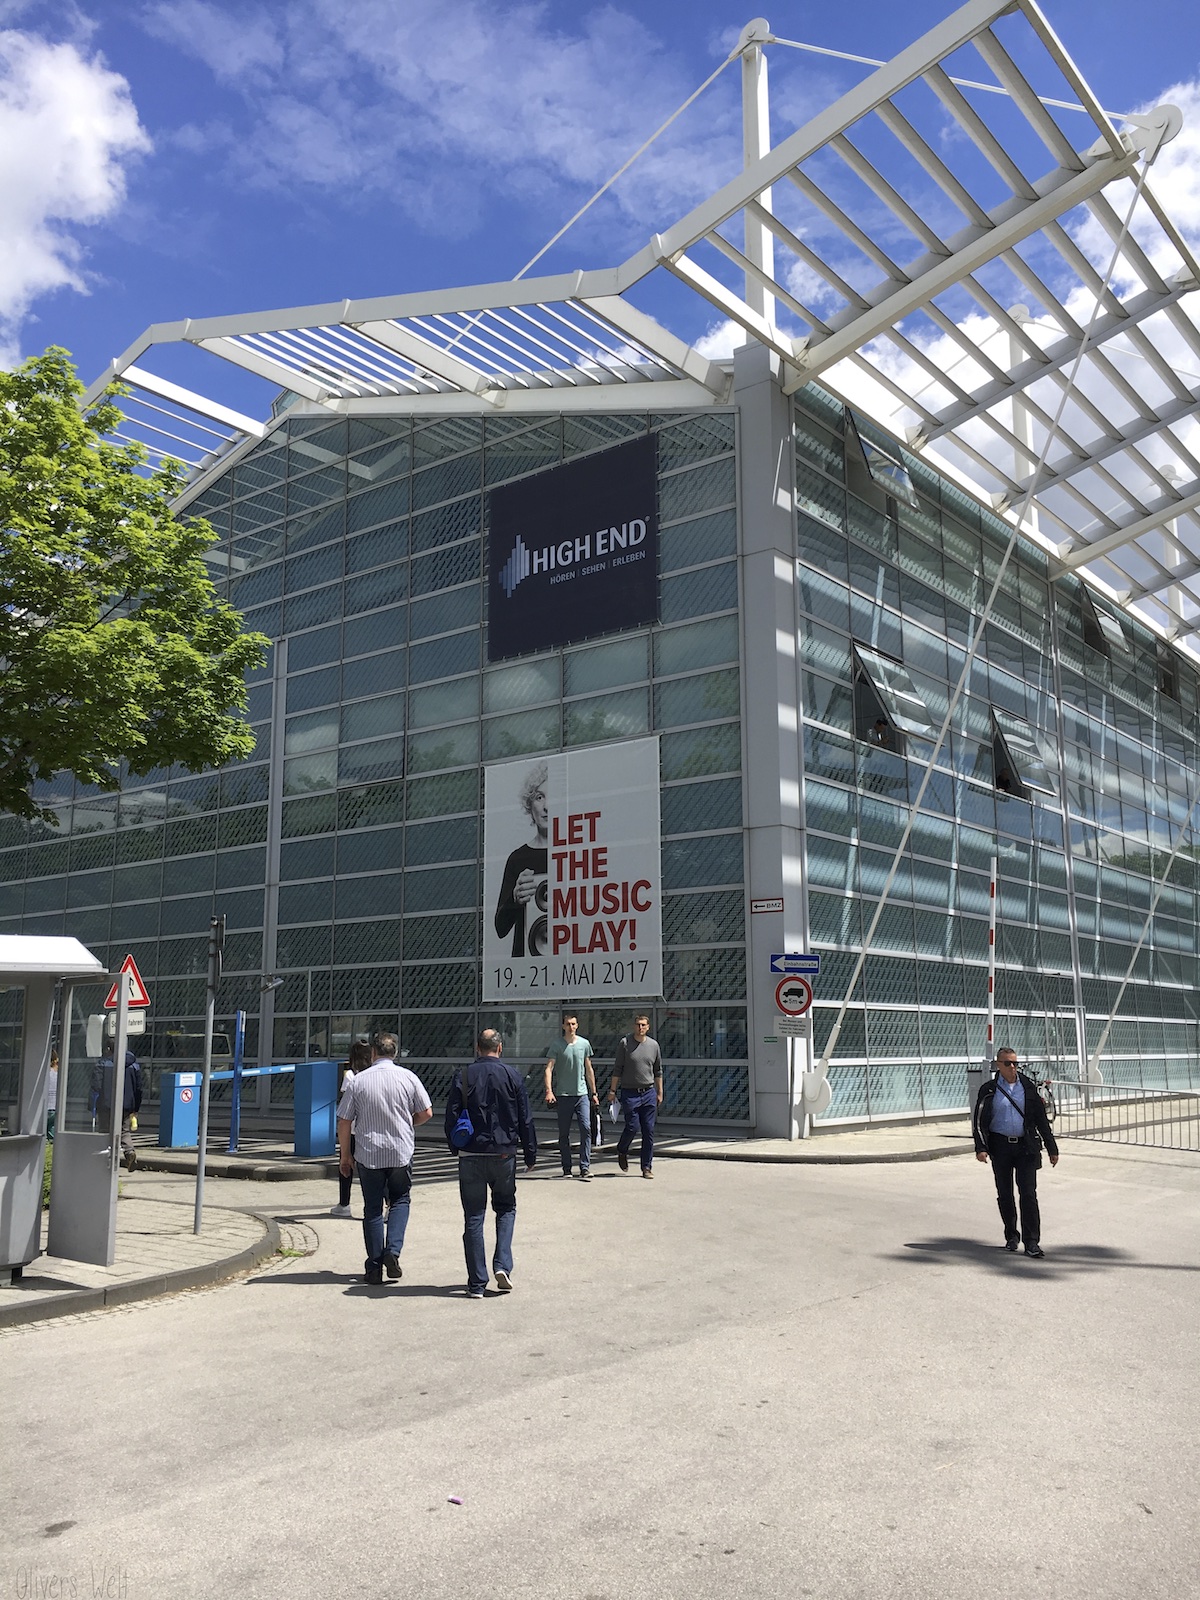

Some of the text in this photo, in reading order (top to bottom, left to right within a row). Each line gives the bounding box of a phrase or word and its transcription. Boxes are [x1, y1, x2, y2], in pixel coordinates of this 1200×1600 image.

[532, 534, 591, 574] HIGH
[550, 550, 646, 585] HÖREN SEHEN ERLEBEN
[552, 811, 601, 847] LET
[551, 847, 608, 882] THE
[552, 879, 652, 919] MUSIC
[552, 918, 637, 956] PLAY!
[561, 962, 595, 986] MAI
[602, 960, 649, 984] 2017
[783, 960, 817, 968] Einbahnstraße
[128, 1019, 143, 1027] fahren
